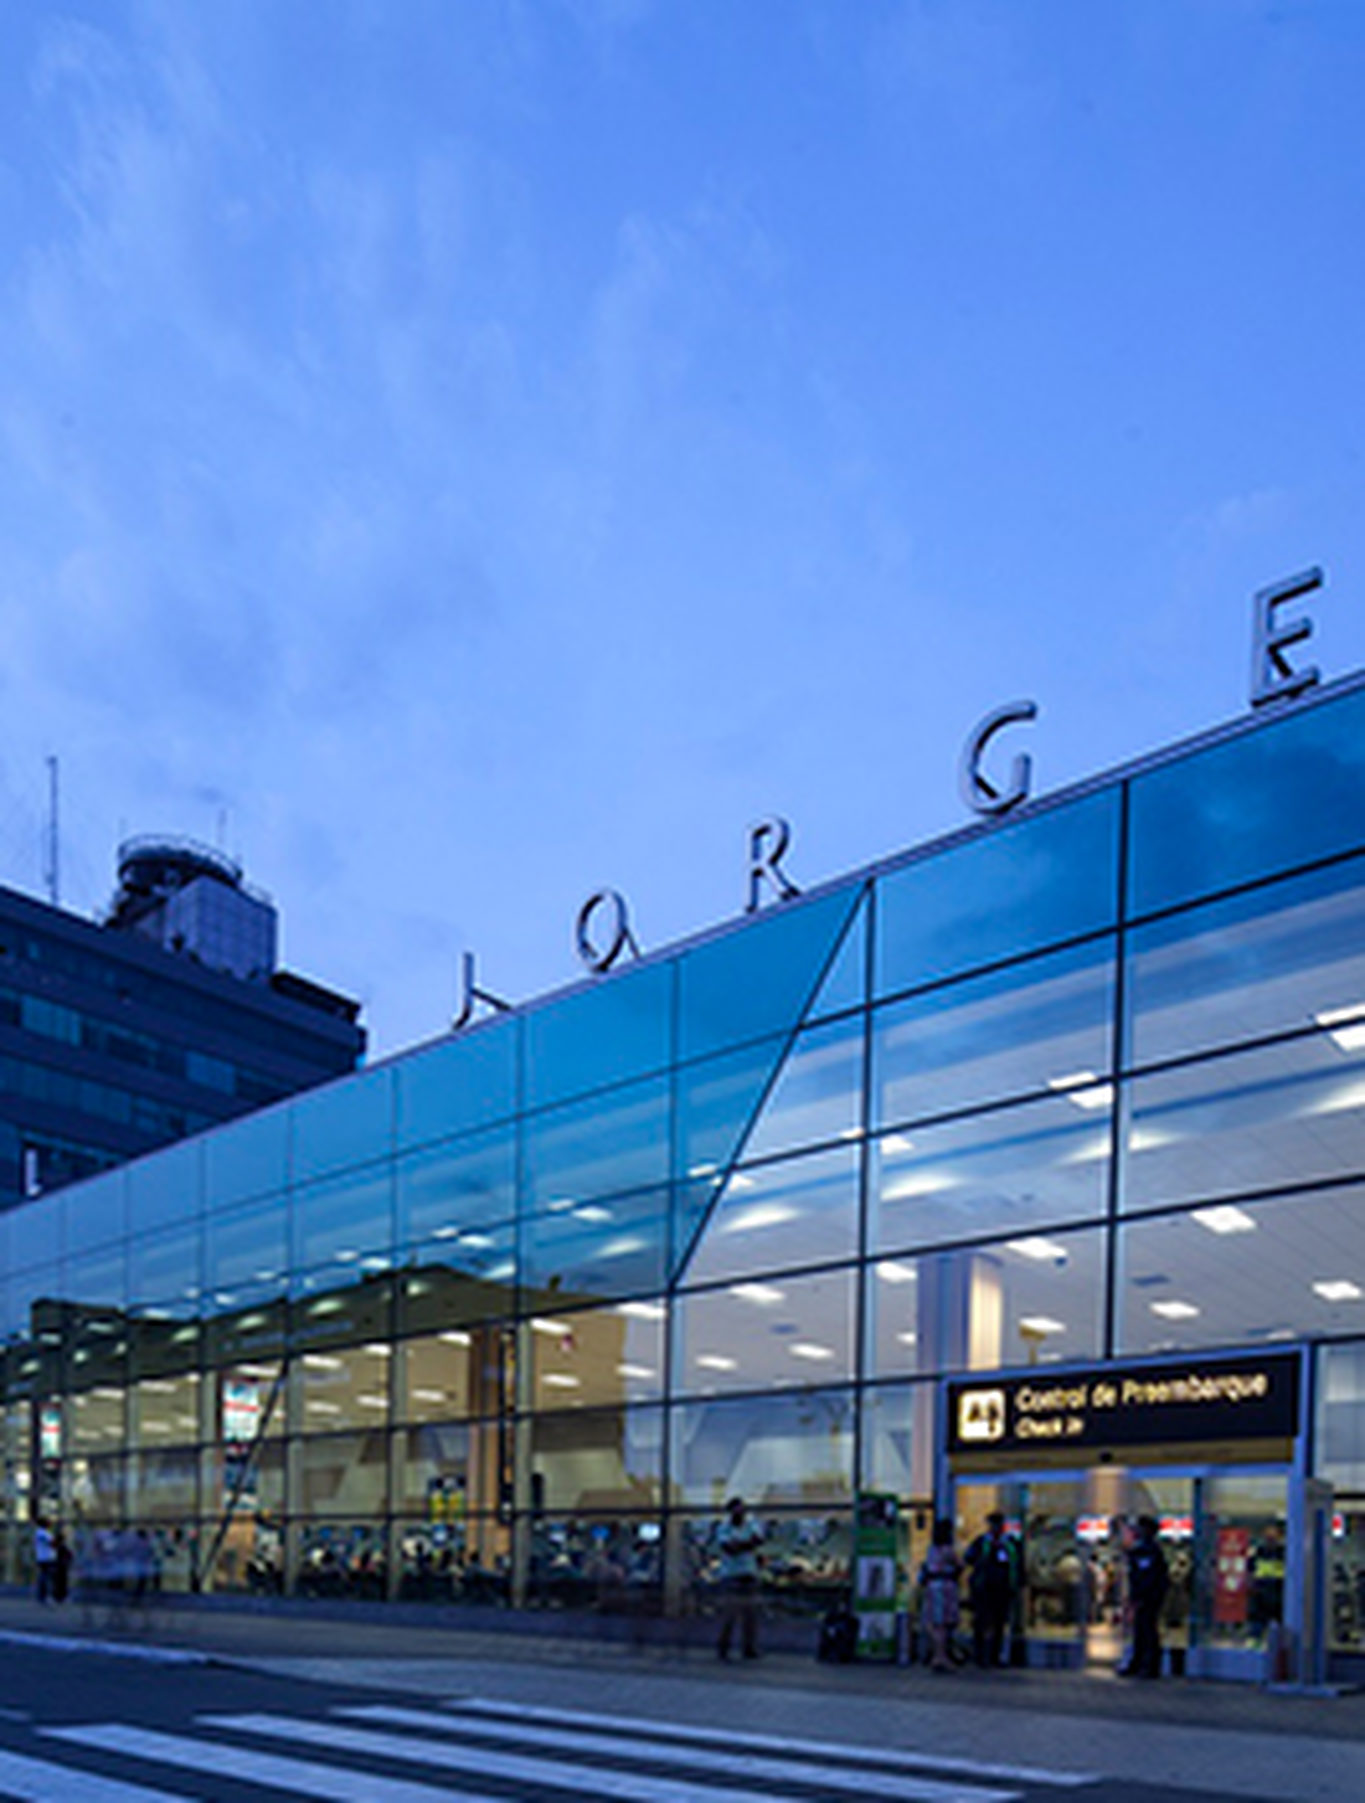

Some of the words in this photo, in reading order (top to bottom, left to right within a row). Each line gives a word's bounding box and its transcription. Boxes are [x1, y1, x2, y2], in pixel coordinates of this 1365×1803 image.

[1015, 1385, 1088, 1413] Control
[1092, 1381, 1117, 1409] de
[1015, 1417, 1062, 1438] Check
